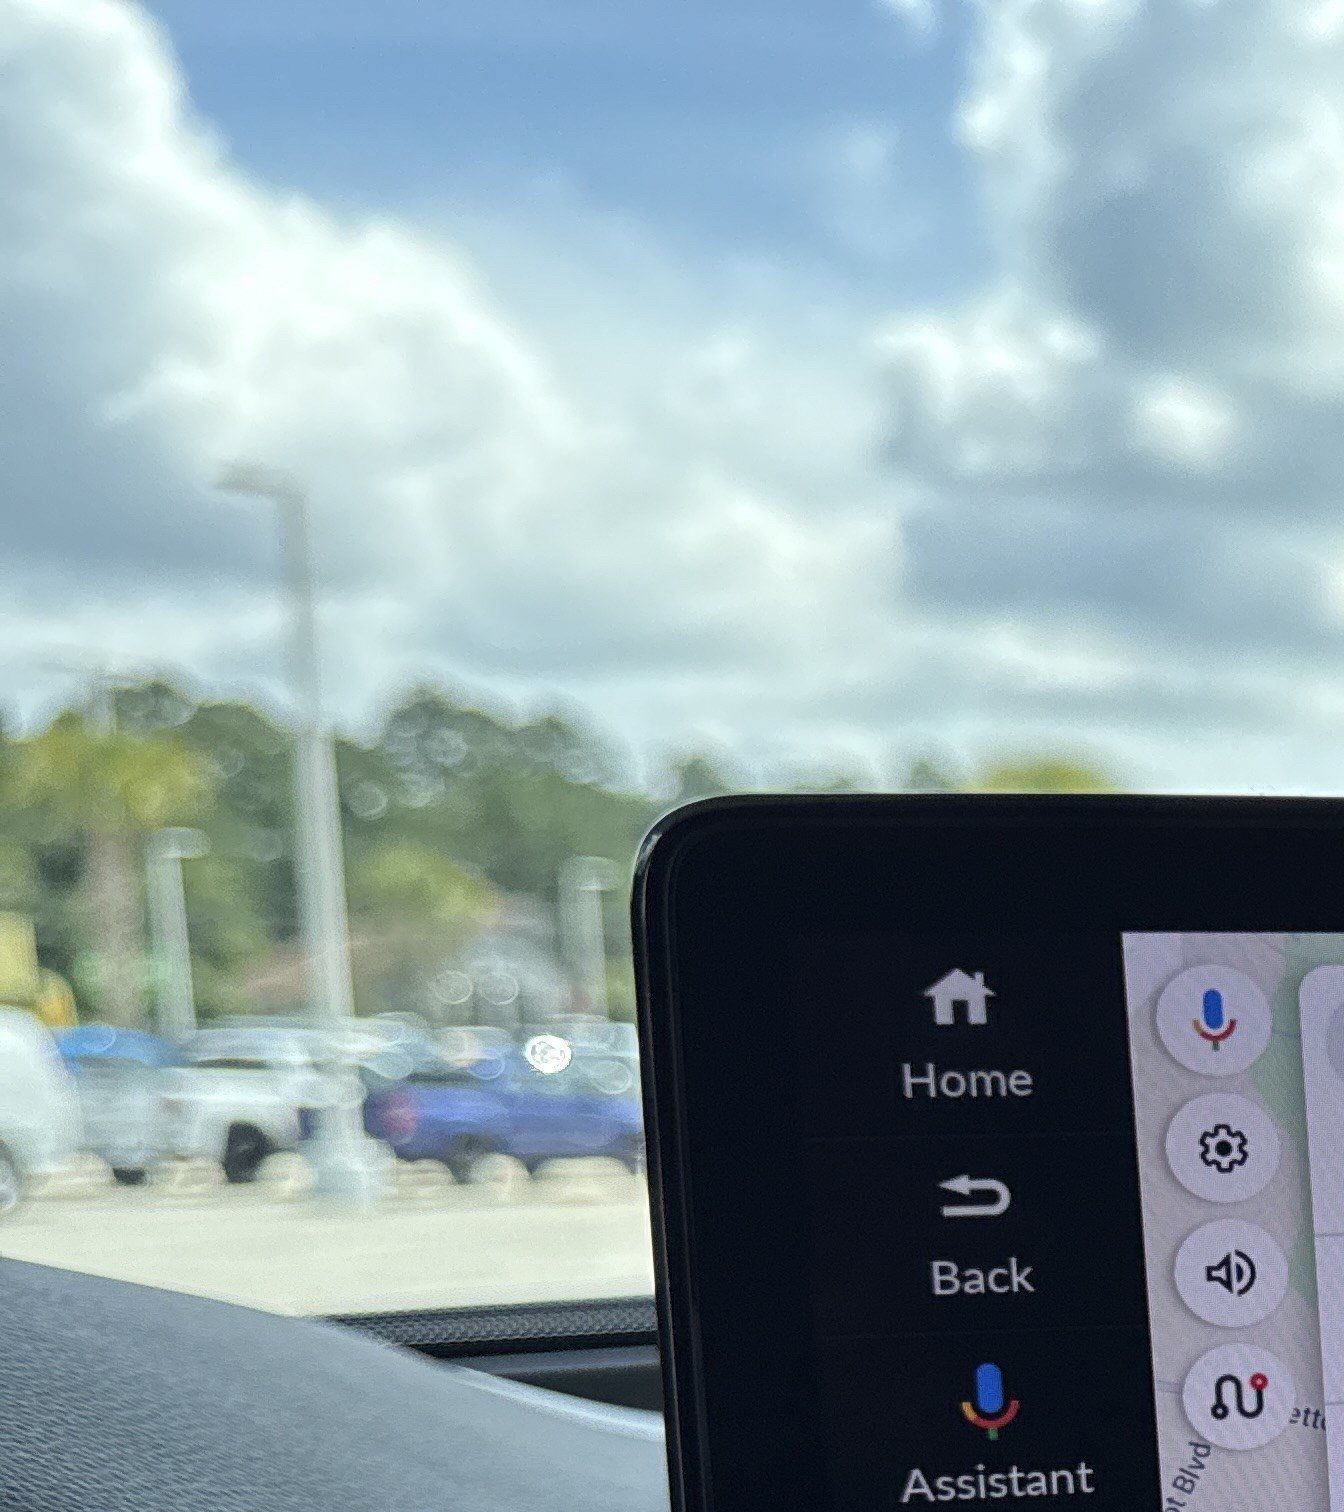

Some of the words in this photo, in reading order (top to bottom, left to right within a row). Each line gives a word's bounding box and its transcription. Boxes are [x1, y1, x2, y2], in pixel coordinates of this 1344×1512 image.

[901, 1062, 1033, 1099] Home
[931, 1258, 1034, 1295] Back
[900, 1462, 1094, 1503] Assistant
[1173, 1442, 1211, 1495] Blvd
